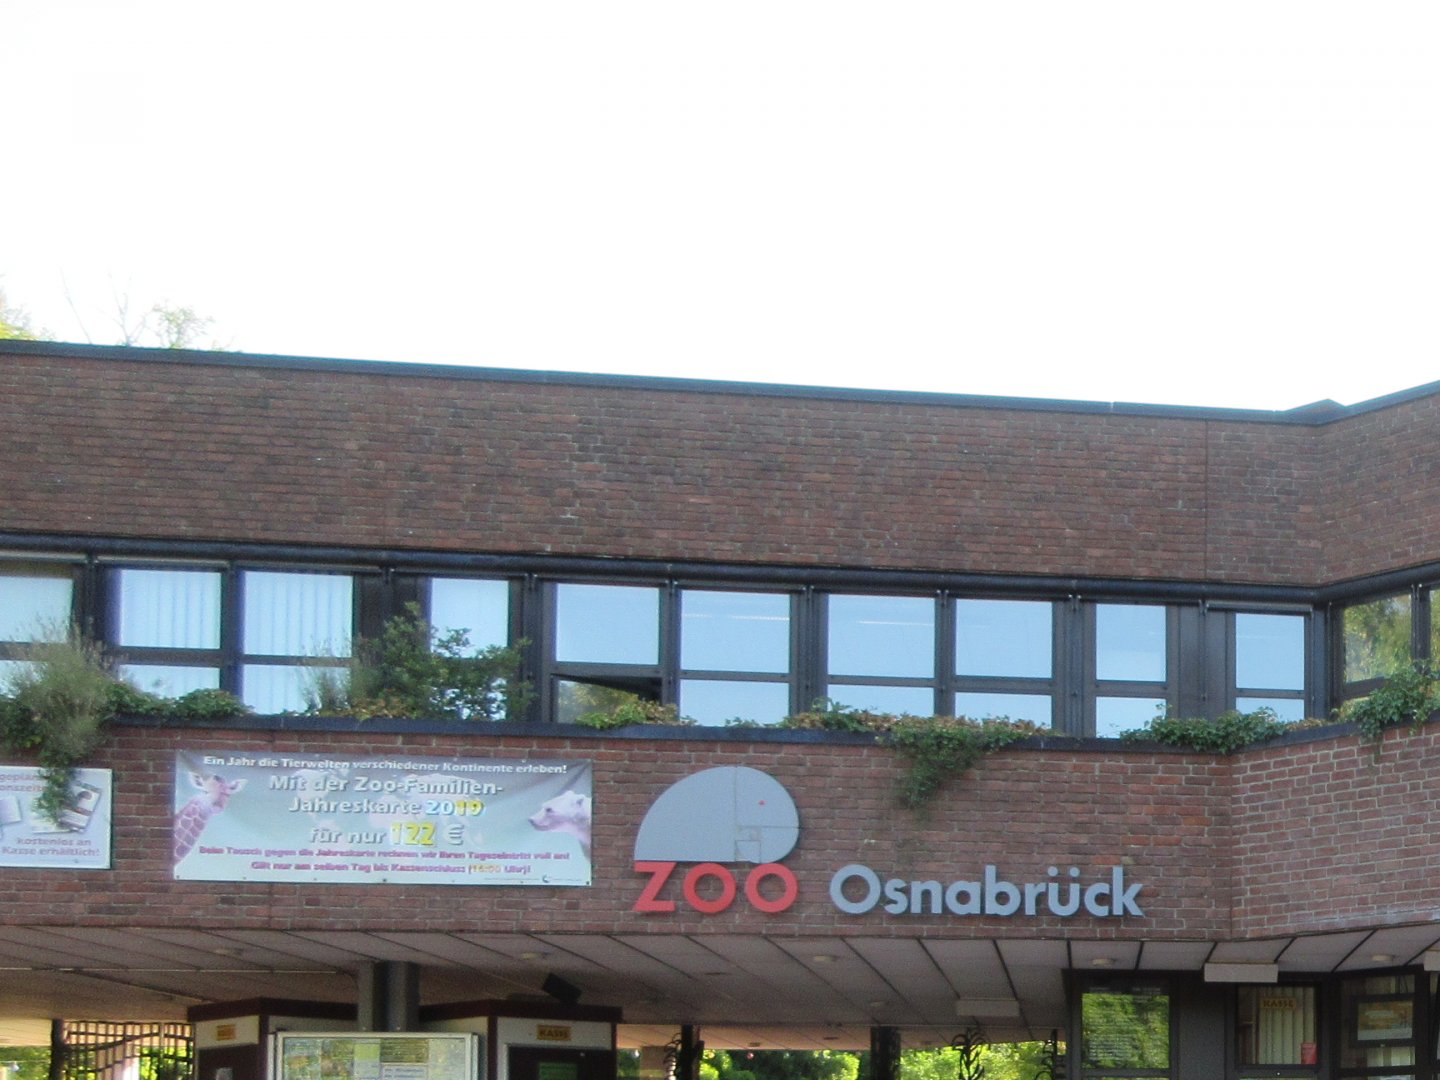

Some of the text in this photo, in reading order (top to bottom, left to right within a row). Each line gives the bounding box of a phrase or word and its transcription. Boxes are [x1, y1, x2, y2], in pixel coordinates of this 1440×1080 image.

[203, 756, 567, 774] Ein Jahr die Tierwelten verschiedener Kontinente erleben!
[270, 775, 504, 796] Mit der Zoo-Familien-
[288, 797, 485, 817] Jahreskarte 2019
[310, 821, 465, 847] für nur 122 €
[829, 864, 1144, 917] Osnabrück
